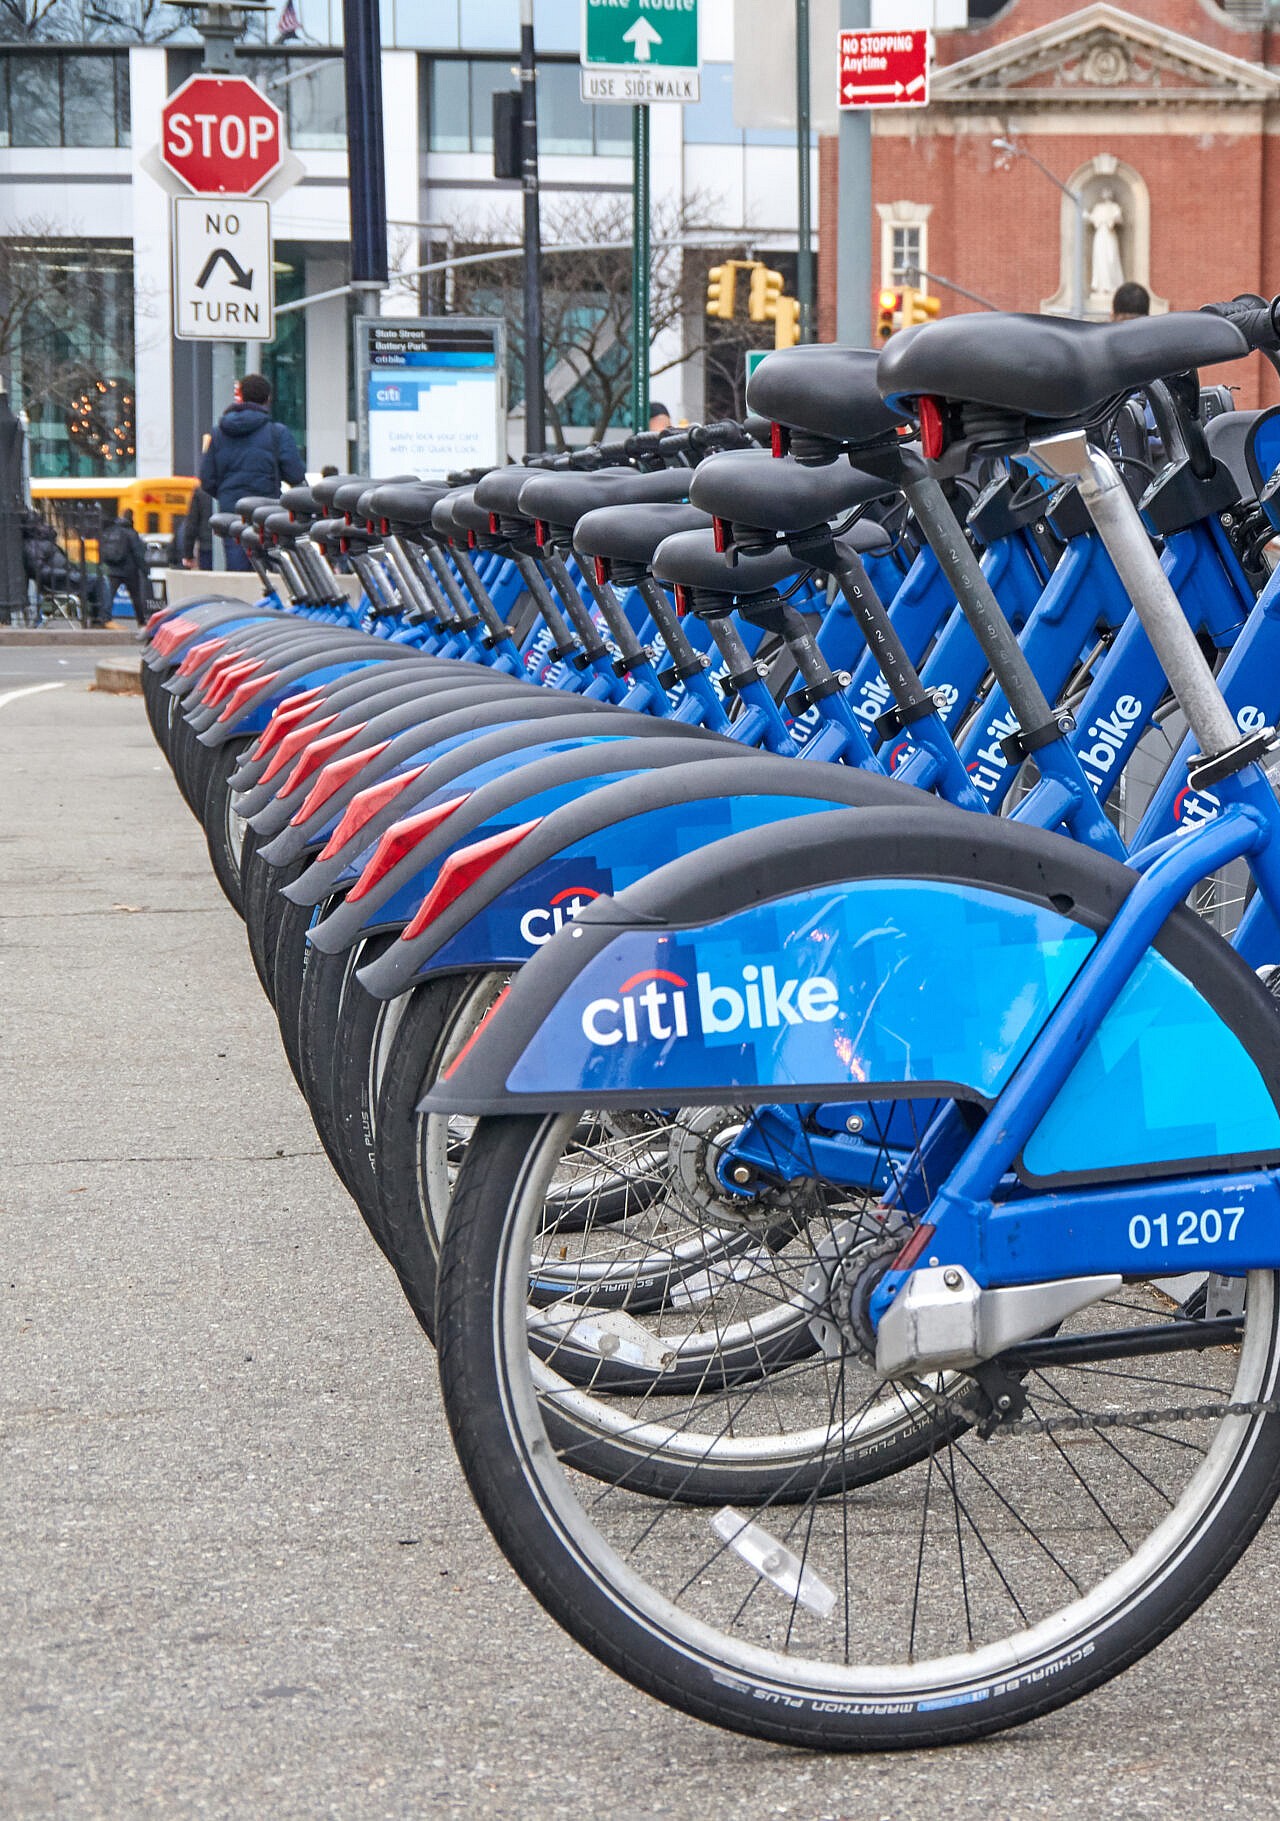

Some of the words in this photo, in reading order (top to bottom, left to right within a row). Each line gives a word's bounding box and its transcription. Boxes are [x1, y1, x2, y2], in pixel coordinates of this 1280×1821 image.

[842, 37, 859, 54] NO
[860, 35, 913, 53] STOPPING
[843, 54, 888, 74] Anytime
[590, 78, 614, 96] USE
[625, 79, 692, 97] SIDEWALK
[167, 112, 275, 159] STOP
[205, 214, 240, 235] NO
[190, 301, 259, 323] TURN
[375, 329, 397, 338] State
[399, 329, 425, 338] Street
[375, 342, 407, 351] Battery
[408, 342, 428, 350] Park
[376, 386, 400, 401] citi
[532, 625, 554, 655] bik
[541, 663, 563, 687] iti
[852, 669, 892, 722] bik
[977, 706, 1021, 769] bik
[1078, 695, 1142, 773] bike
[966, 761, 1002, 804] ti
[520, 887, 601, 945] cit
[581, 969, 689, 1046] citi
[697, 965, 839, 1034] bike
[1128, 1207, 1245, 1249] 01207
[858, 1436, 897, 1458] PLUS
[993, 1641, 1096, 1697] SCHWALBE
[753, 1688, 804, 1708] PLUS
[811, 1701, 914, 1715] MARATHON
